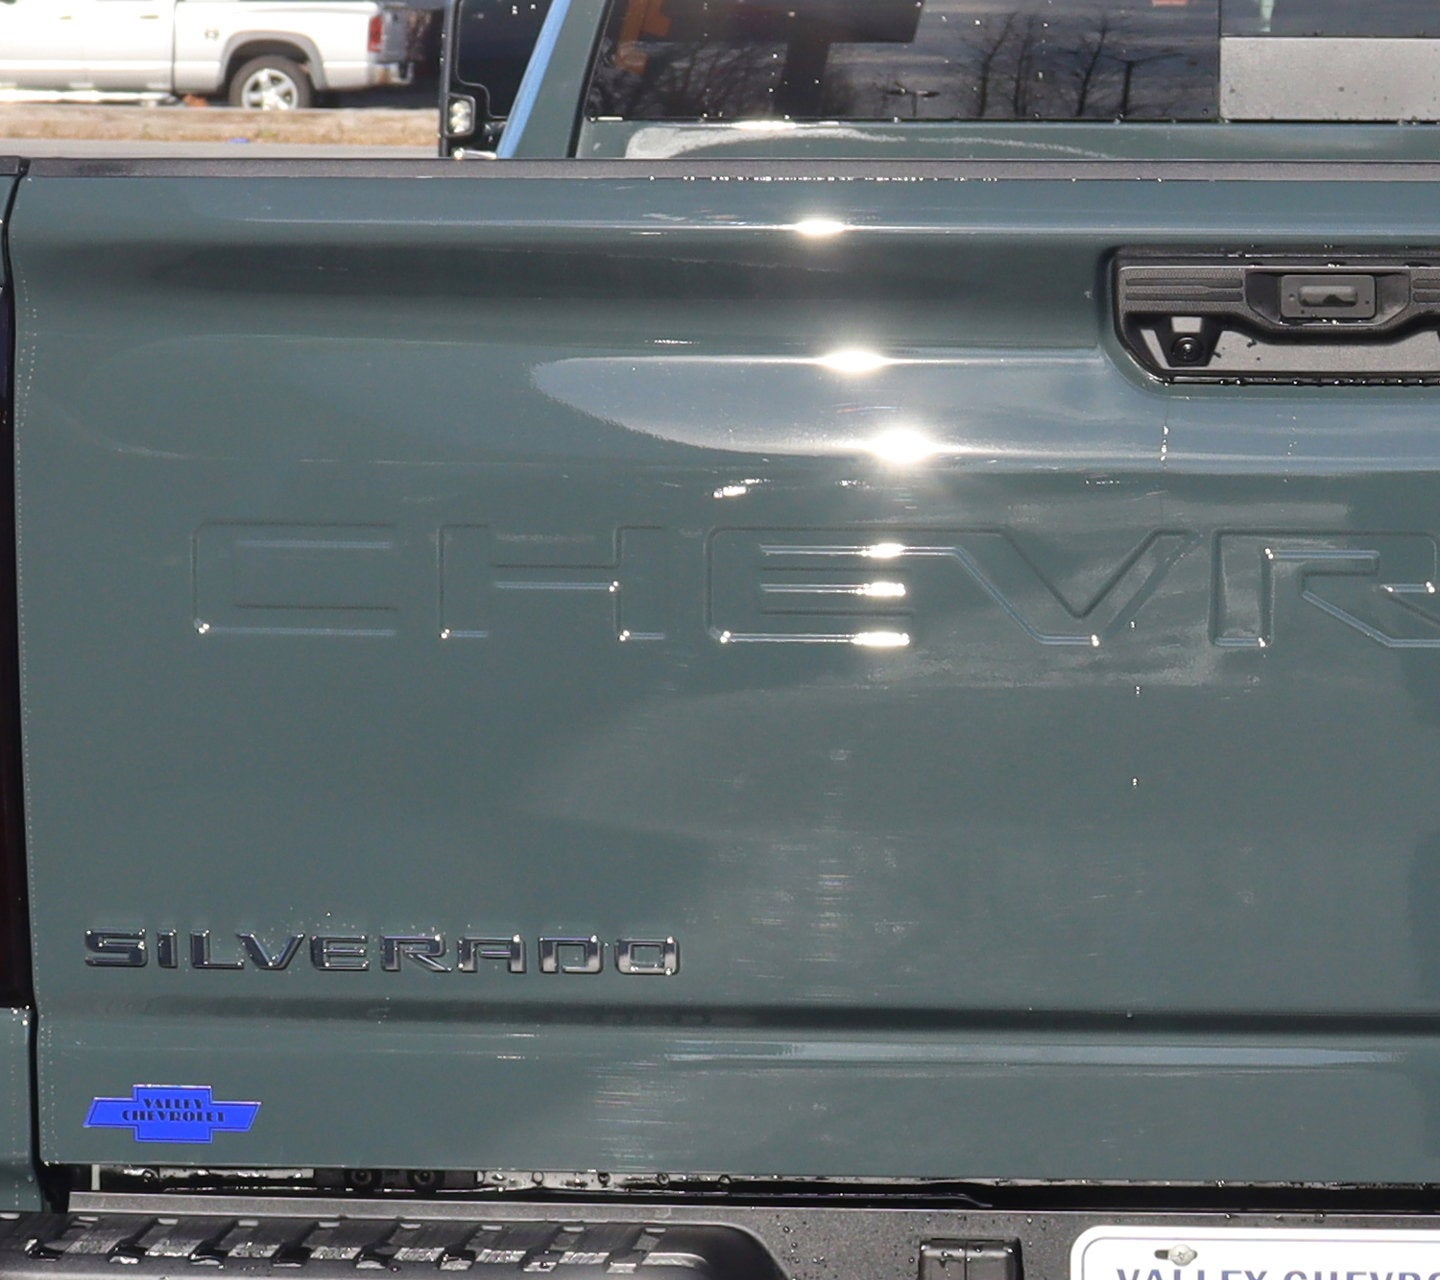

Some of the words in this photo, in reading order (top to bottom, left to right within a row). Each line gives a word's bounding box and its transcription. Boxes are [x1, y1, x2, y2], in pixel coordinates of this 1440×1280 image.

[84, 928, 681, 975] SILVERADO
[143, 1098, 204, 1110] VALLEY
[122, 1110, 226, 1123] CHEVROLET
